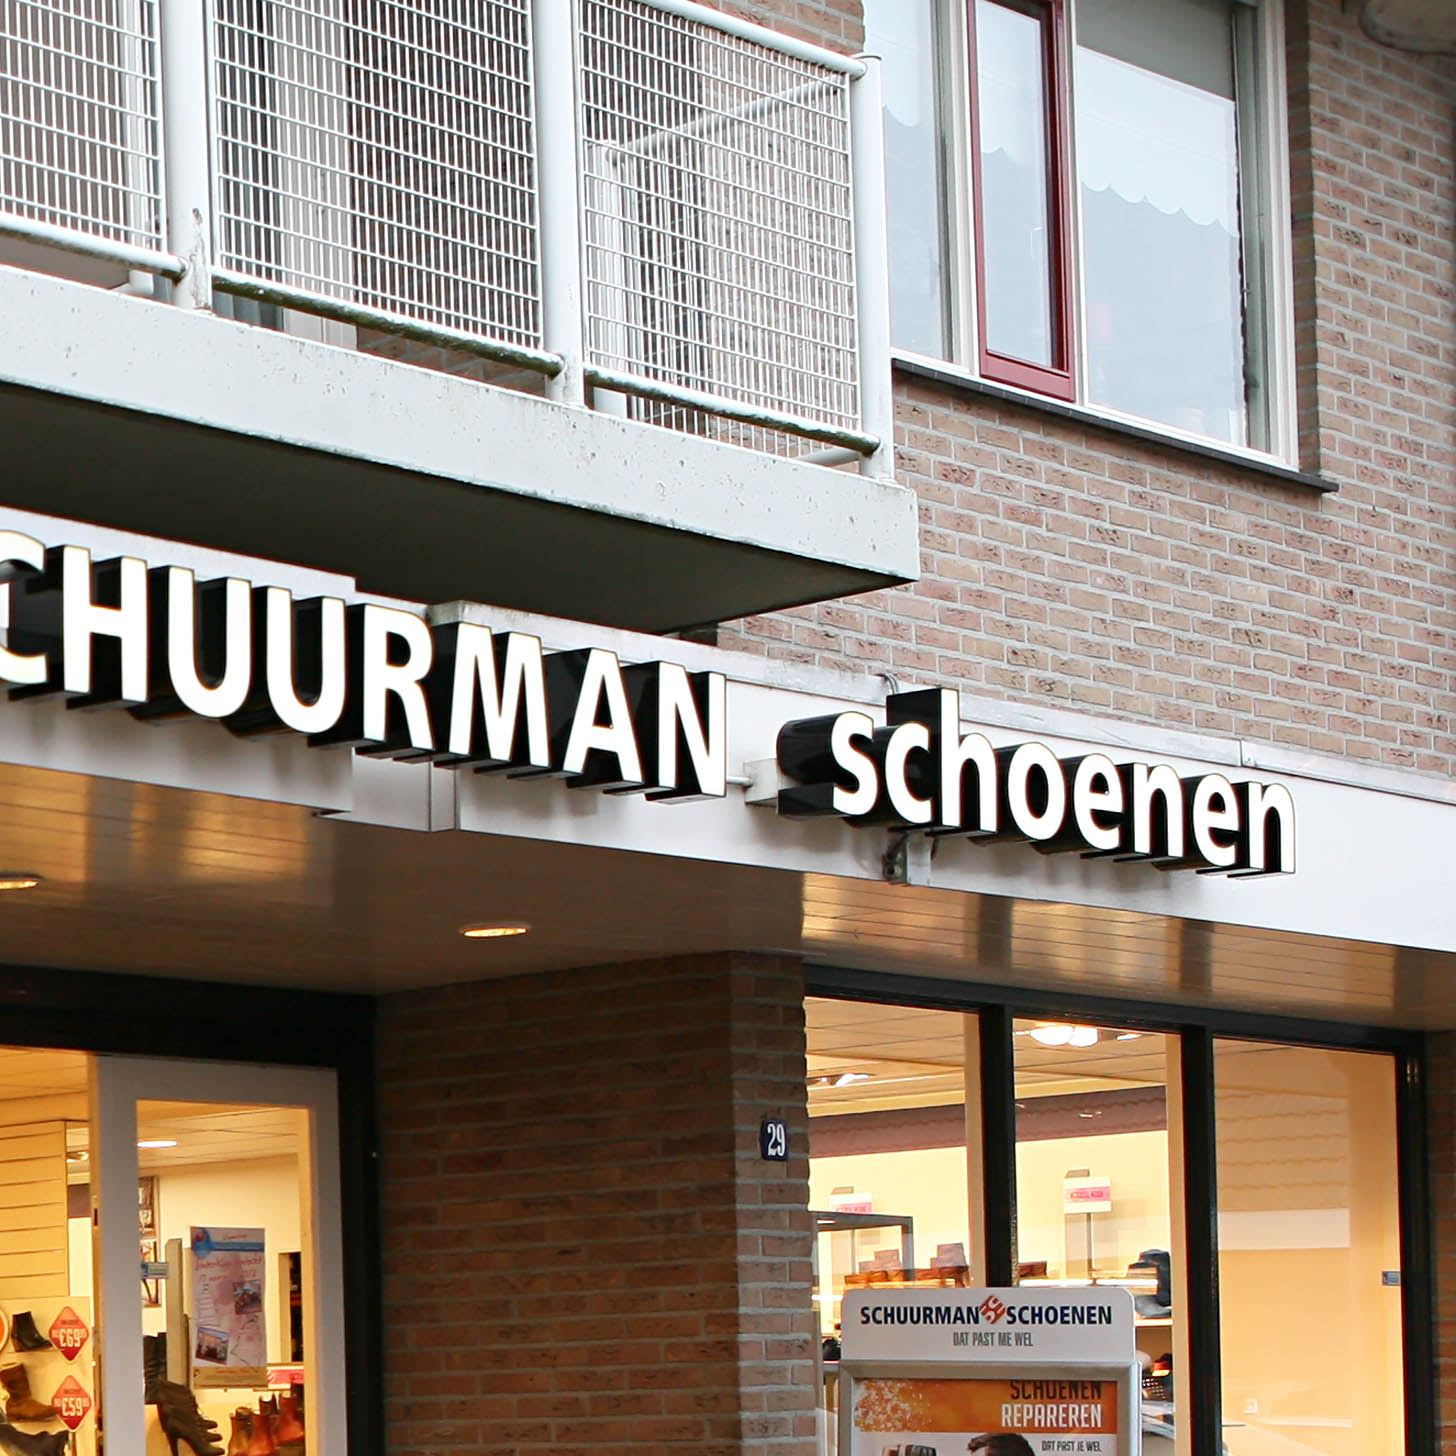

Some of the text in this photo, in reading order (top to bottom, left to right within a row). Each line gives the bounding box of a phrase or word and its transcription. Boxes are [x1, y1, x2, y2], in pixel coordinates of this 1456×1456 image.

[829, 687, 1297, 875] schoenen
[767, 1123, 786, 1157] 29
[860, 1305, 1112, 1325] SCHUURMAN SCHOENEN
[953, 1332, 1033, 1347] DAT PAST ME WEL
[1009, 1380, 1102, 1400] SCHOENEN
[1001, 1403, 1102, 1428] REPAREREN
[1041, 1440, 1055, 1451] DAT
[1057, 1440, 1075, 1451] PAST
[1086, 1441, 1102, 1452] WEL
